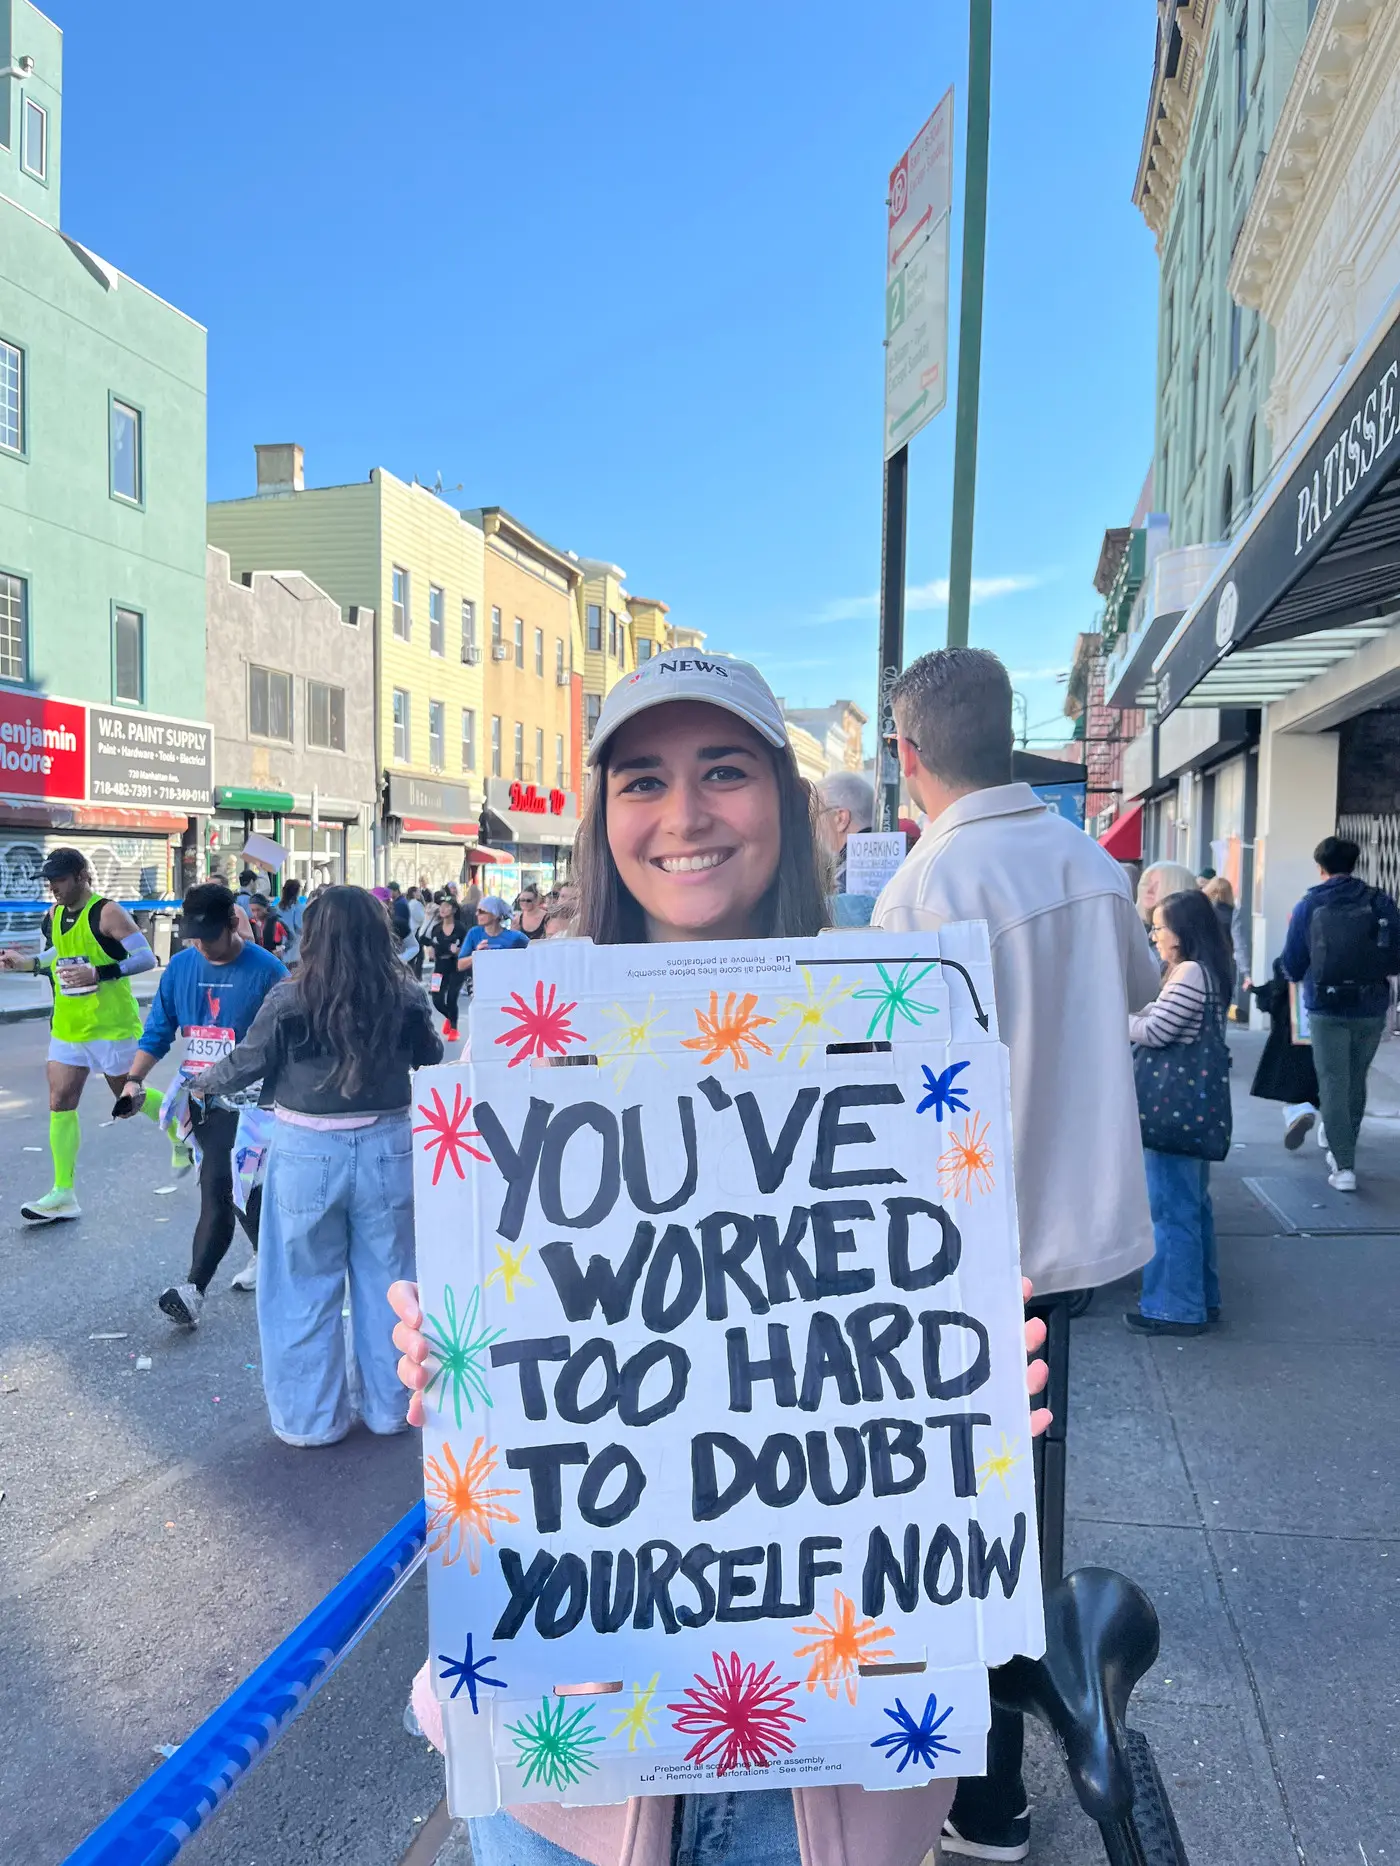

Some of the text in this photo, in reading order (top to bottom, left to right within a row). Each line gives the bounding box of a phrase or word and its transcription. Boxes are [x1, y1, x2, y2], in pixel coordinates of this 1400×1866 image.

[1295, 360, 1400, 556] PATISSE
[660, 660, 728, 678] NEWS
[0, 719, 77, 752] enjamin
[98, 717, 207, 751] W.R. PAINT SUPPLY
[98, 742, 206, 767] Paint Hardware Tools Electrical
[851, 840, 900, 857] NO PARKING
[666, 955, 791, 967] Lid Remove at perforations
[756, 965, 792, 974] Prebend
[669, 967, 696, 976] before
[699, 967, 717, 975] lines
[719, 966, 742, 974] score
[744, 966, 754, 974] all
[187, 1039, 232, 1056] 43570
[473, 1076, 908, 1242] YOU'VE
[539, 1197, 961, 1333] WORKED
[490, 1303, 991, 1427] TOO HARD
[506, 1413, 992, 1533] TO DOUBT
[492, 1512, 1027, 1641] YOURSELF NOW
[640, 1774, 655, 1782] Lid
[666, 1772, 702, 1781] Remove
[705, 1771, 714, 1779] at
[779, 1766, 796, 1774] See
[654, 1764, 691, 1773] Prebend
[693, 1763, 704, 1771] all
